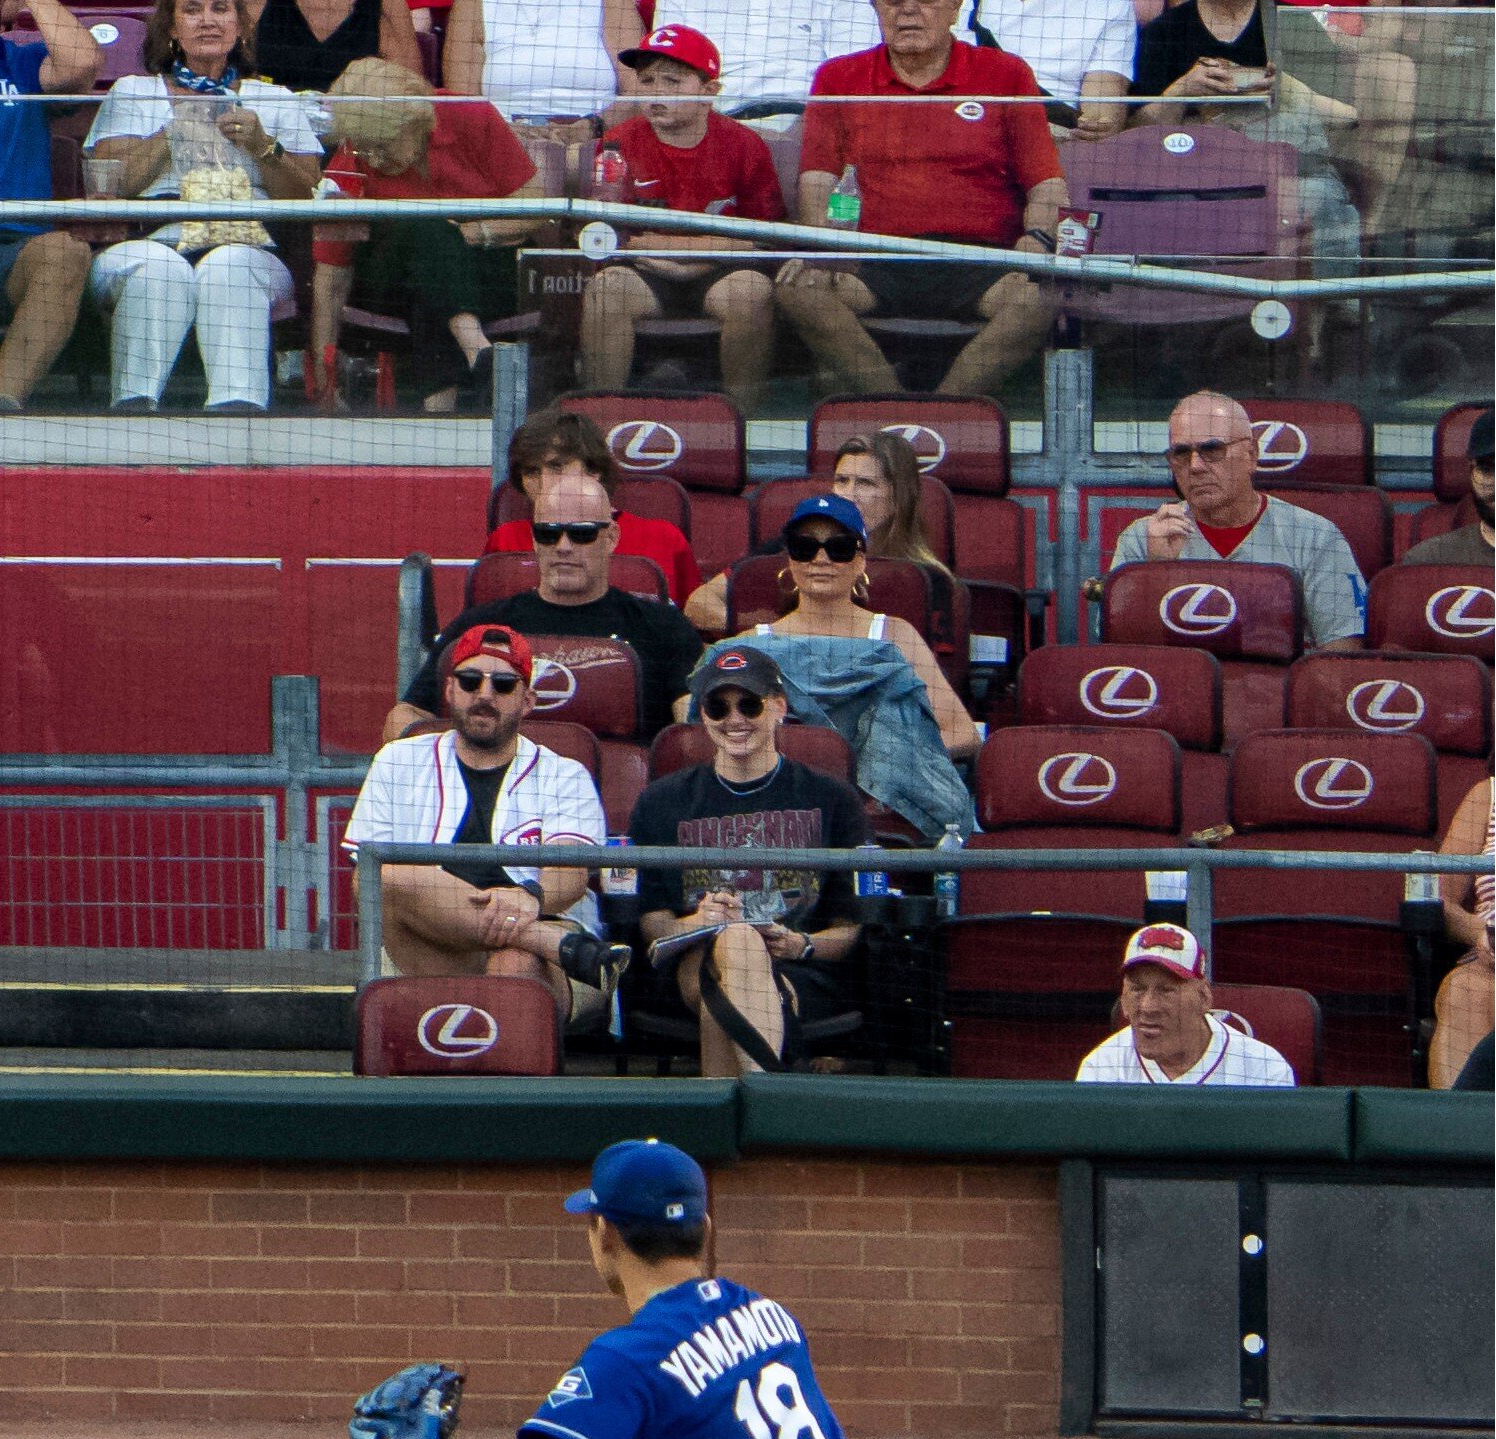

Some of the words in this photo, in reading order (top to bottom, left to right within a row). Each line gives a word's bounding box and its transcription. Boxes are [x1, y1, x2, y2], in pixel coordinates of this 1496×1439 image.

[648, 28, 679, 47] C
[717, 652, 747, 670] C
[660, 1299, 801, 1397] YAMAMOTO
